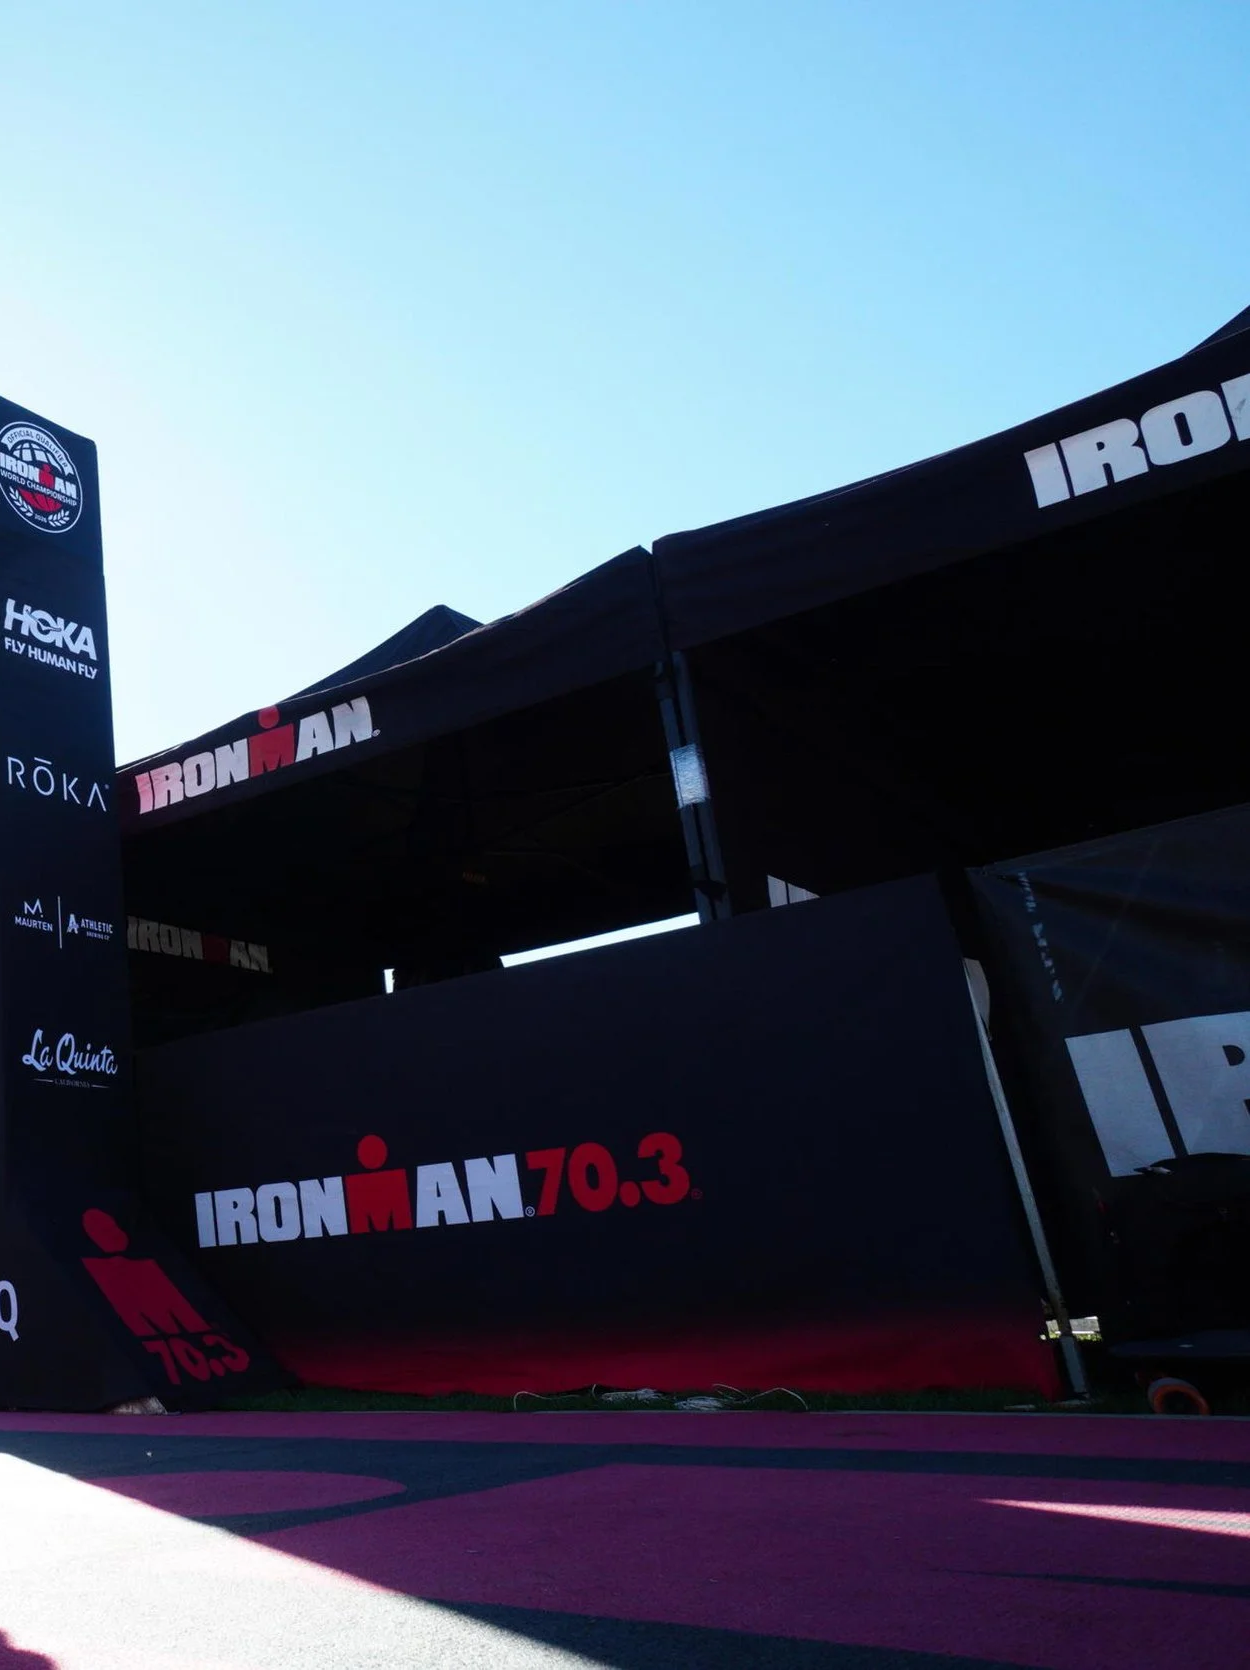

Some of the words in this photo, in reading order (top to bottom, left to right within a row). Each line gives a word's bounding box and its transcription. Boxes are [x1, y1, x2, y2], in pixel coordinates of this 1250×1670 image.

[7, 429, 34, 443] OFFICIAL
[35, 433, 68, 468] QUALIFIER
[0, 451, 77, 500] IRONMAN
[0, 469, 26, 485] WORLD
[26, 481, 77, 507] CHAMPIONSHIP
[4, 598, 98, 660] HOKA
[4, 636, 26, 655] FLY
[28, 645, 83, 673] HUMAN
[78, 661, 98, 680] FLY
[135, 697, 373, 814] IRONMAN
[14, 916, 54, 932] MAURTEN
[81, 918, 114, 934] ATHLETIC
[22, 1028, 54, 1072] La
[56, 1032, 119, 1075] Quinta
[194, 1133, 525, 1248] IRONMAN
[525, 1132, 691, 1216] 70.3
[142, 1334, 250, 1385] 70.3
